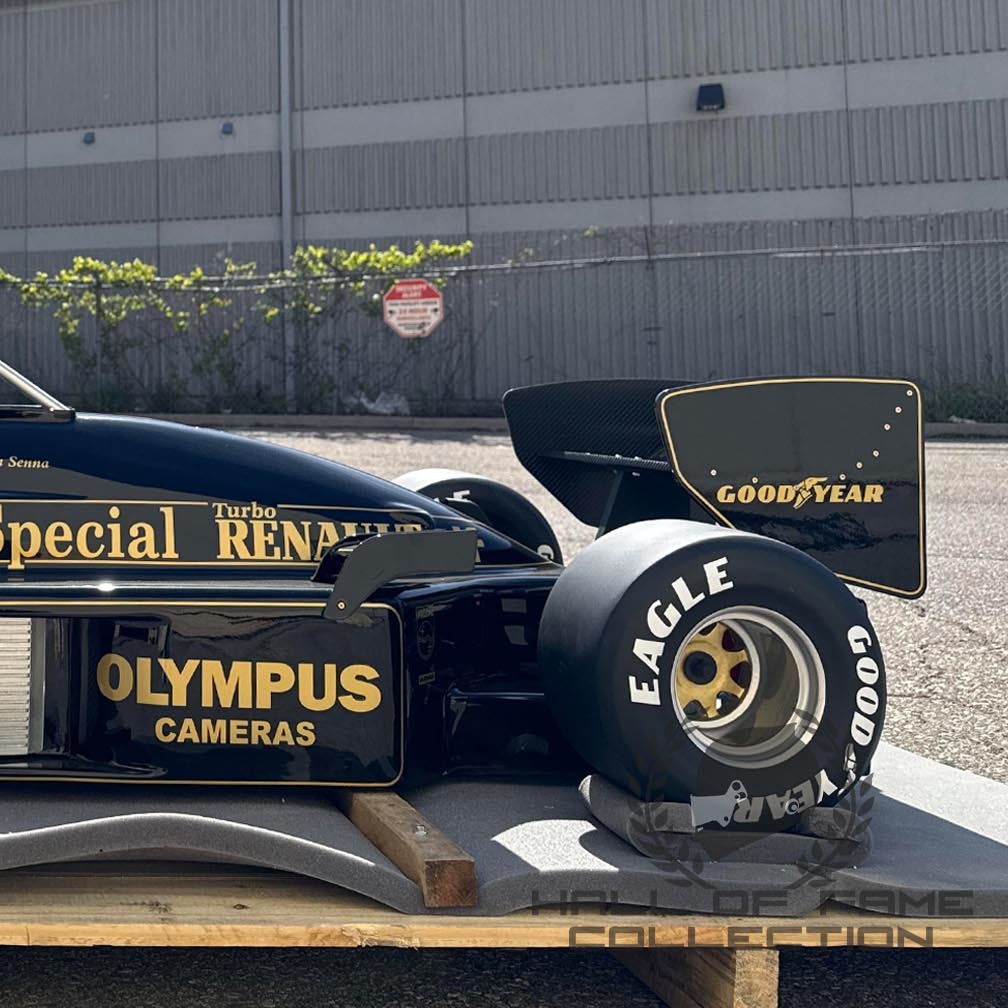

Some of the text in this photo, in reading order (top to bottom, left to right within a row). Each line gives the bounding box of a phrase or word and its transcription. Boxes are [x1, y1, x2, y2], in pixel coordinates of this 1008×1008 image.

[8, 456, 49, 469] Senna
[212, 501, 277, 520] Turbo
[215, 518, 422, 562] RENA
[628, 556, 734, 706] EAGLE
[96, 653, 383, 713] OLYMPUS
[847, 625, 880, 747] GOOD
[154, 716, 317, 747] CAMERAS
